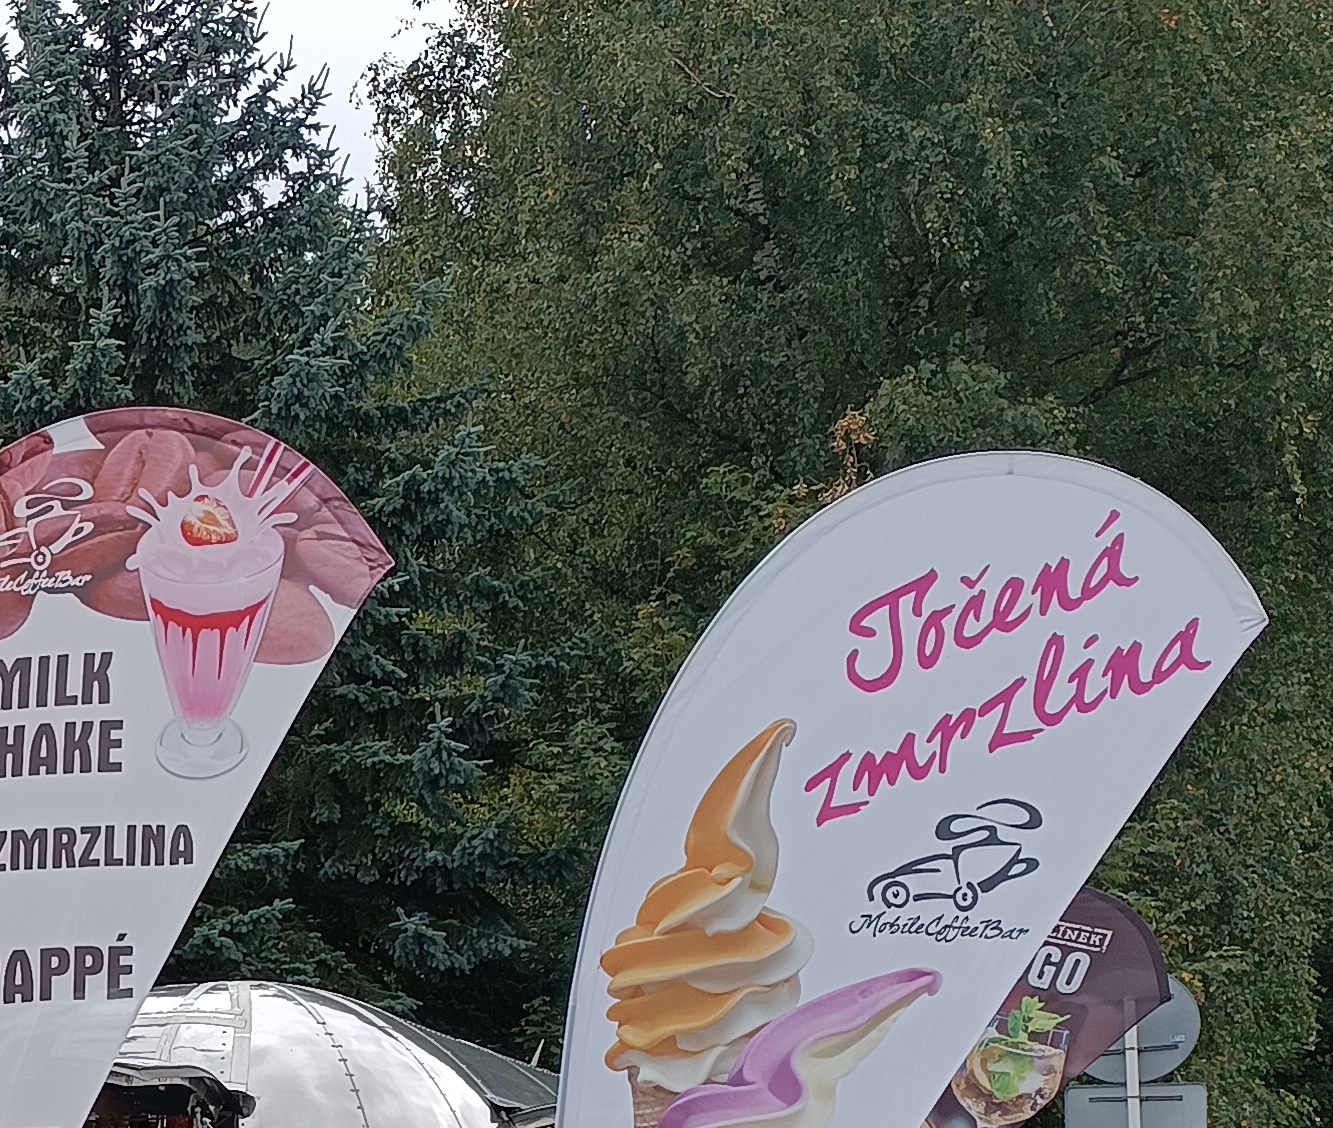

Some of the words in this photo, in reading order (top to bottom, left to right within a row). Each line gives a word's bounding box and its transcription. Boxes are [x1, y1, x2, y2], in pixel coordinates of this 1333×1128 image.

[846, 509, 1139, 693] Točená
[804, 616, 1212, 827] zmrzlina
[1028, 945, 1091, 994] GO
